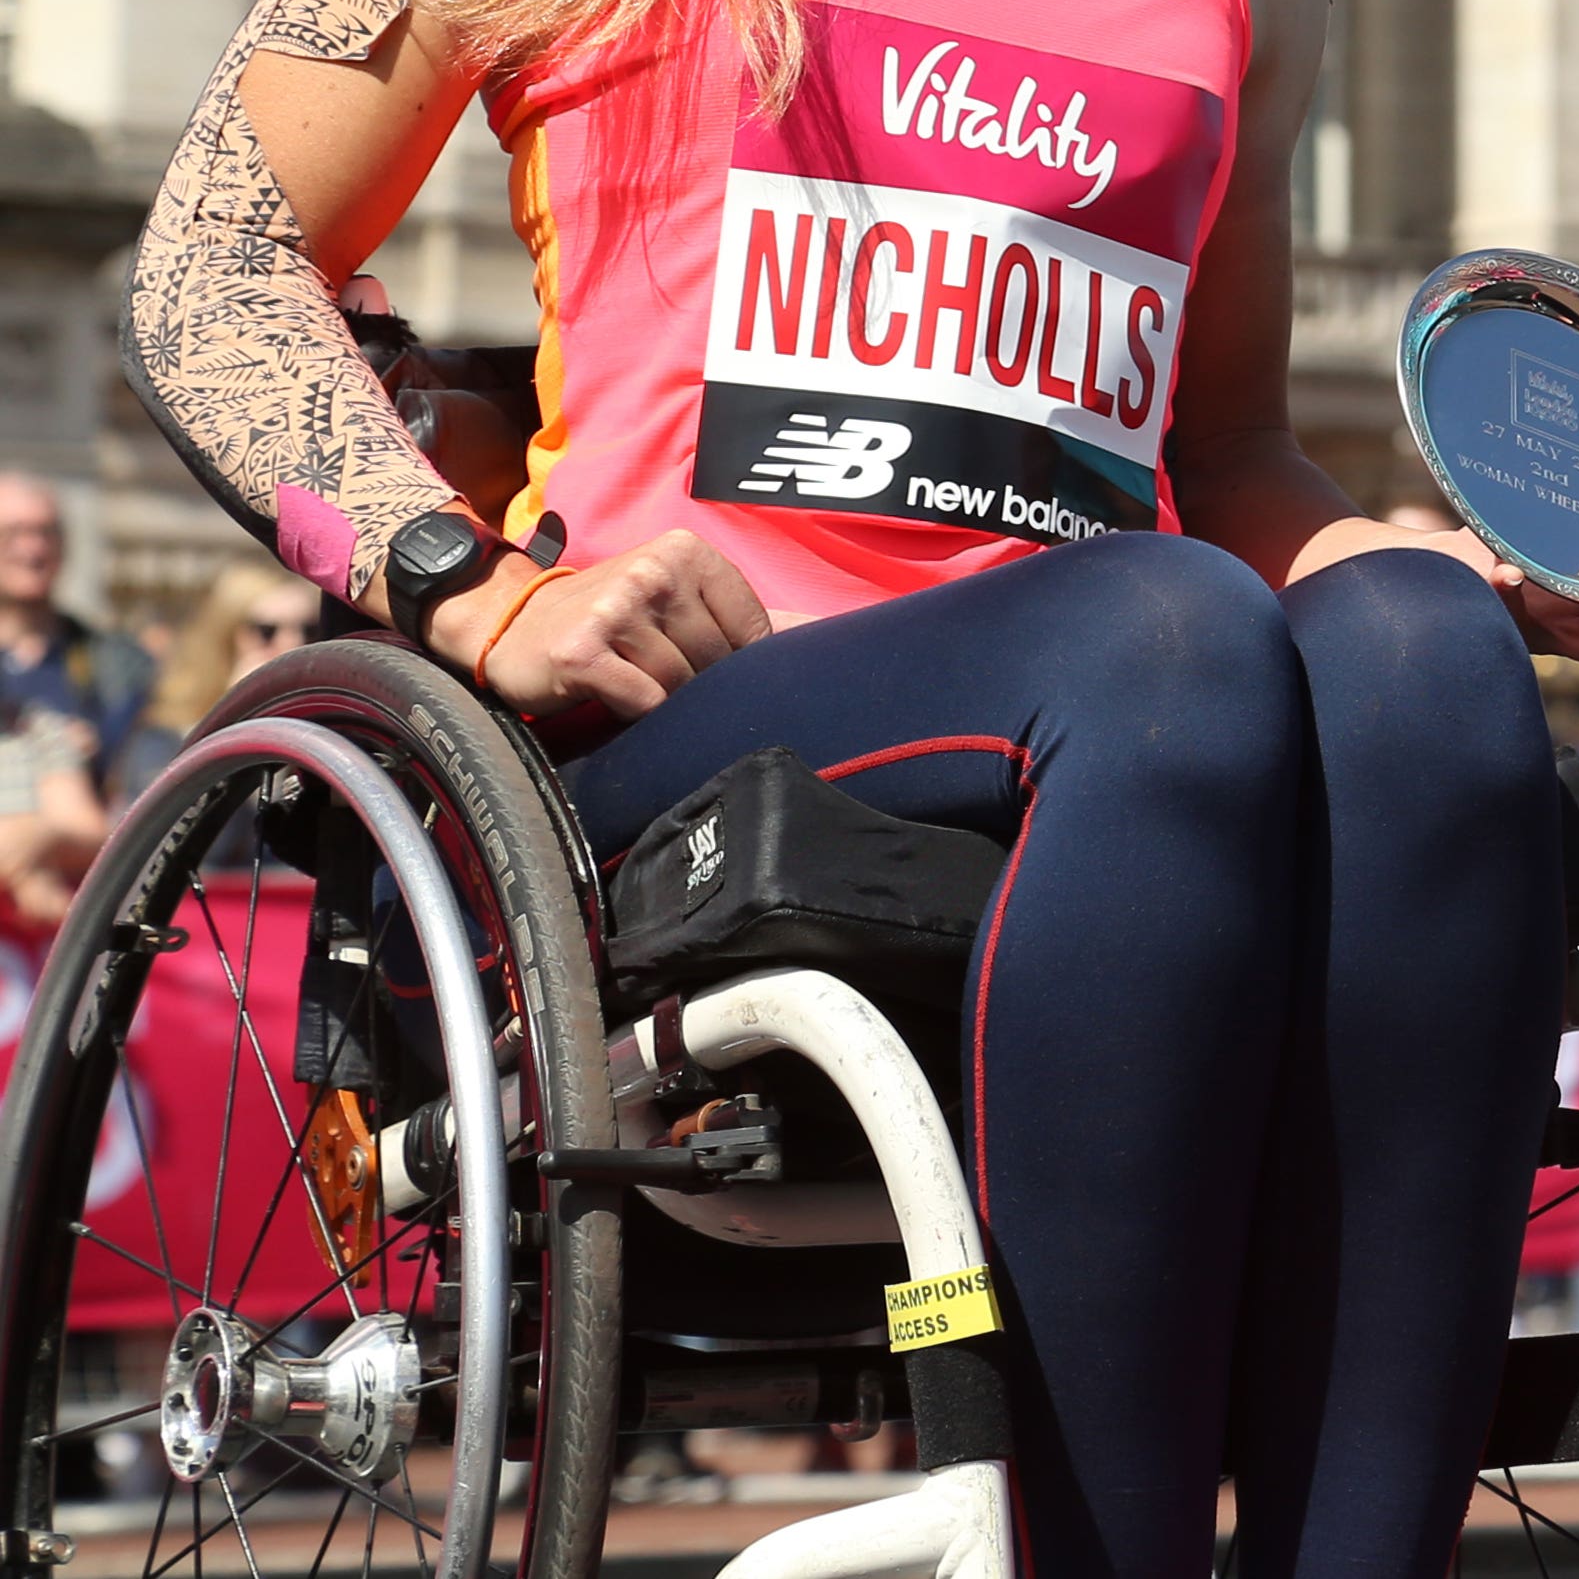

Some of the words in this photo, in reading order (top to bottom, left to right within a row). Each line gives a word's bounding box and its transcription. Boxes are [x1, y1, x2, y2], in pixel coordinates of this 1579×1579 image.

[882, 41, 1118, 209] Vitality
[735, 210, 1165, 430] NICHOLLS
[1481, 421, 1505, 438] 27
[1516, 434, 1562, 461] MAY
[1457, 453, 1526, 492] WOMAN
[1530, 461, 1569, 487] 2nd
[907, 476, 996, 518] new
[887, 1271, 989, 1313] CHAMPIONS
[894, 1313, 949, 1344] ACCESS
